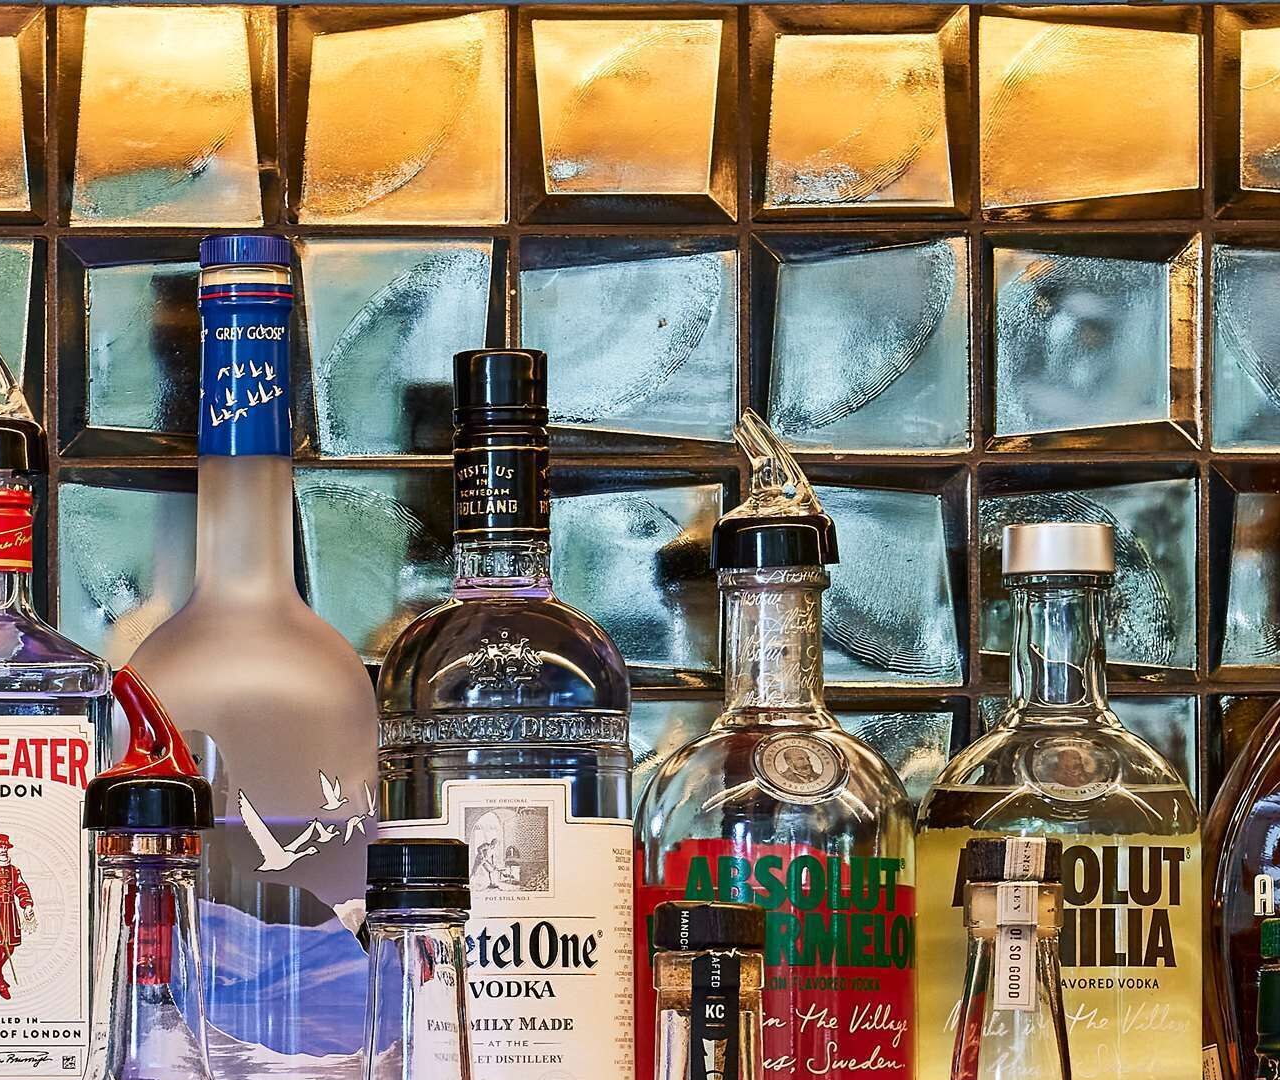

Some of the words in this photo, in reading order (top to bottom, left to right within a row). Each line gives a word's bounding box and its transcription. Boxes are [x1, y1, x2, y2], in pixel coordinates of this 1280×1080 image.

[216, 327, 242, 340] GREY
[247, 325, 281, 340] GOOSE
[685, 855, 899, 912] ABSOLUT
[529, 920, 598, 970] One
[469, 981, 555, 999] VODKA
[1118, 979, 1159, 989] VODKA
[705, 1005, 724, 1018] KC
[0, 1030, 17, 1038] OF
[23, 1030, 81, 1038] LONDON
[495, 1054, 563, 1064] DISTILLERY
